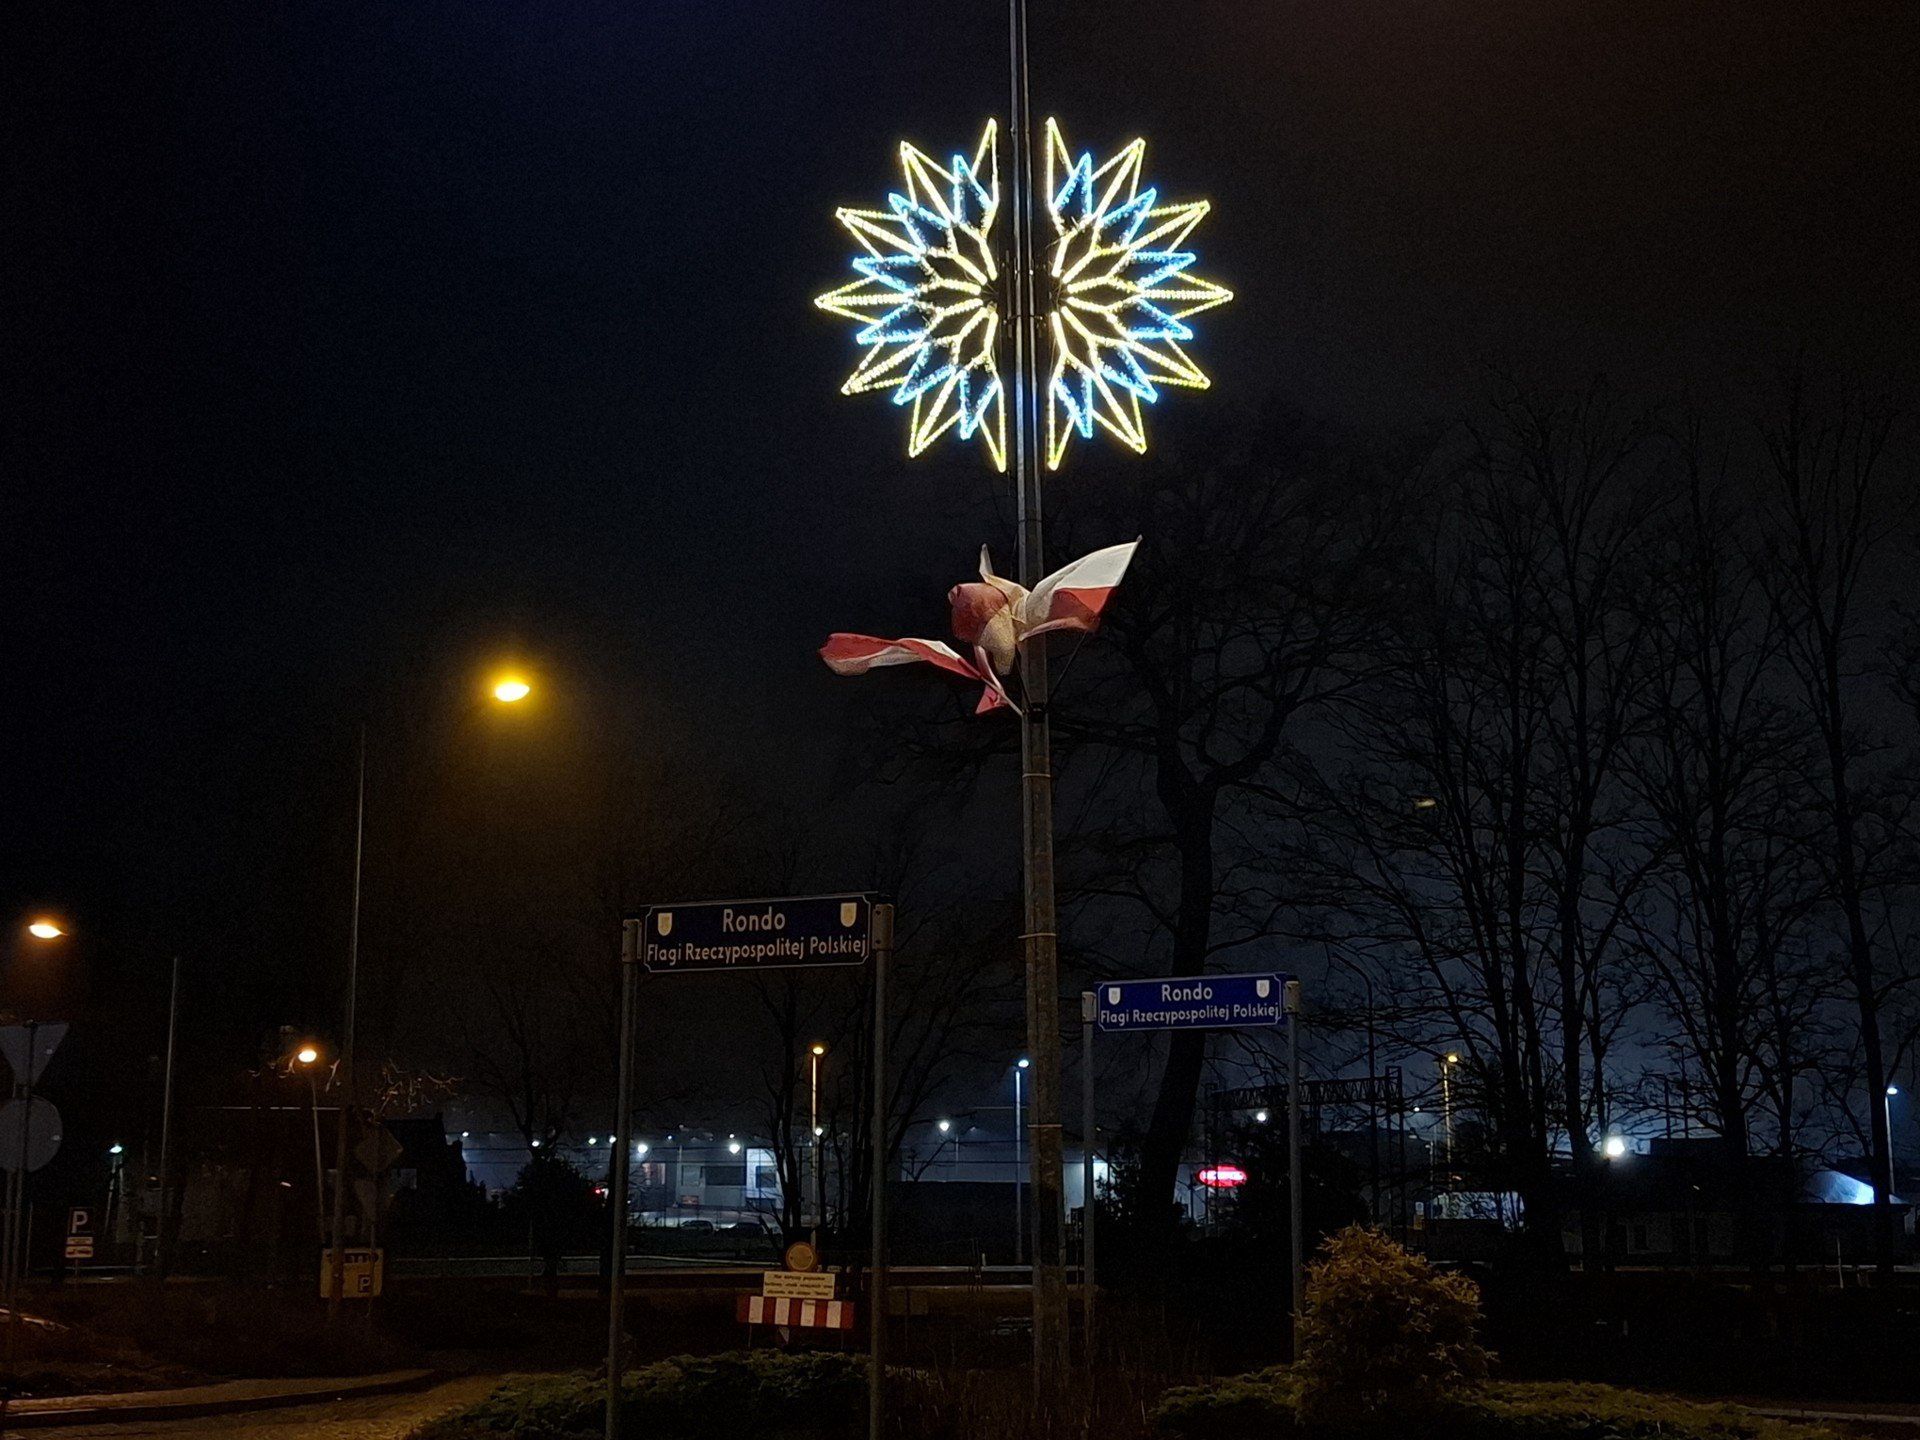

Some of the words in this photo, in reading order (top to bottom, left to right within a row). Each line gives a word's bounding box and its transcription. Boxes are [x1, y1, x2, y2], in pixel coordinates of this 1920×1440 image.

[723, 906, 786, 933] Rondo
[647, 943, 682, 966] Flagi
[685, 937, 805, 963] Rzeczypospolitej
[810, 935, 868, 957] Polskiej
[1161, 982, 1213, 1002] Rondo
[1100, 1010, 1130, 1027] Flagi
[1132, 1004, 1230, 1024] Rzeczypospolitej
[1234, 1003, 1279, 1018] Polskiej
[71, 1211, 88, 1234] P
[359, 1277, 371, 1291] P
